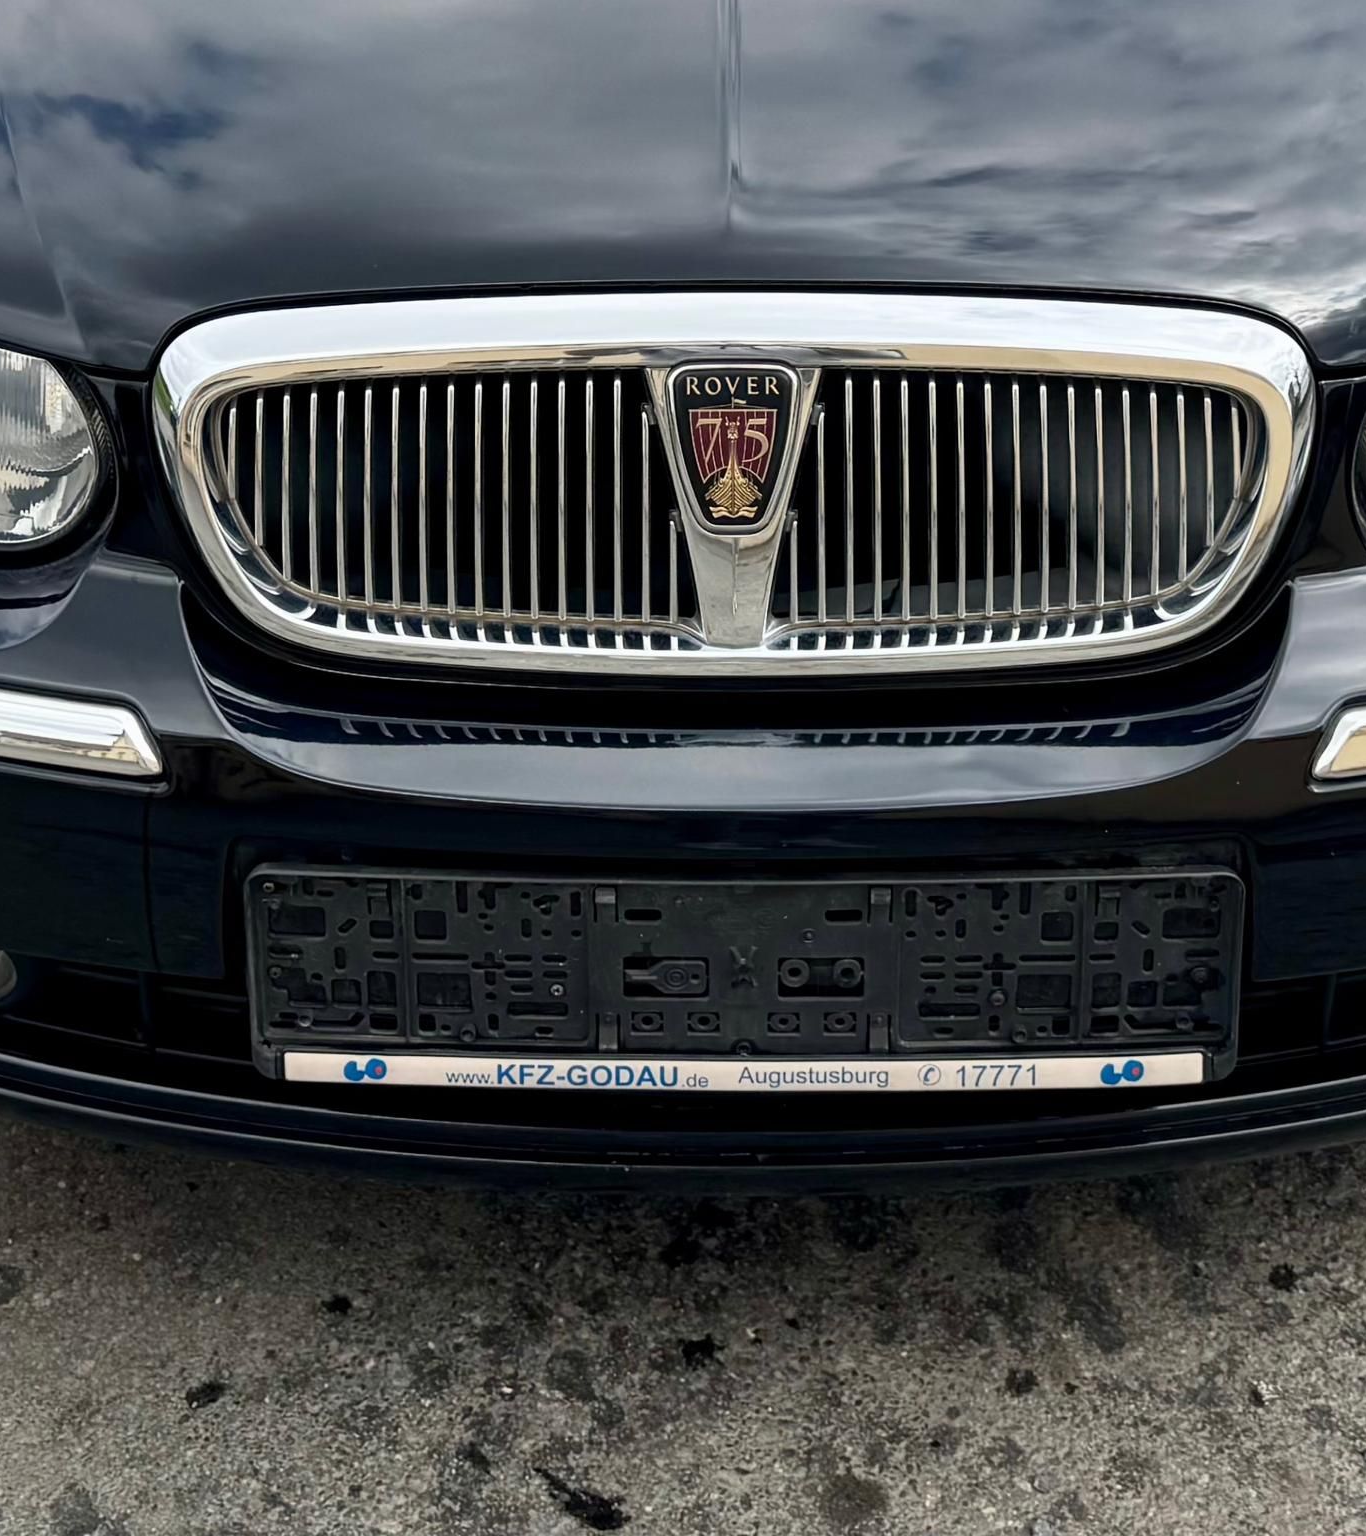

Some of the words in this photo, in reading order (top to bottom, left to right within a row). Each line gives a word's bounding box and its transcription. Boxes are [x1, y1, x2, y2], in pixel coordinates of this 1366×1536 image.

[685, 376, 780, 395] ROVER
[695, 417, 770, 463] 75
[445, 1063, 710, 1089] www.KFZ-GODAU.de
[737, 1065, 890, 1088] Augustusburg
[955, 1064, 1037, 1087] 17771
